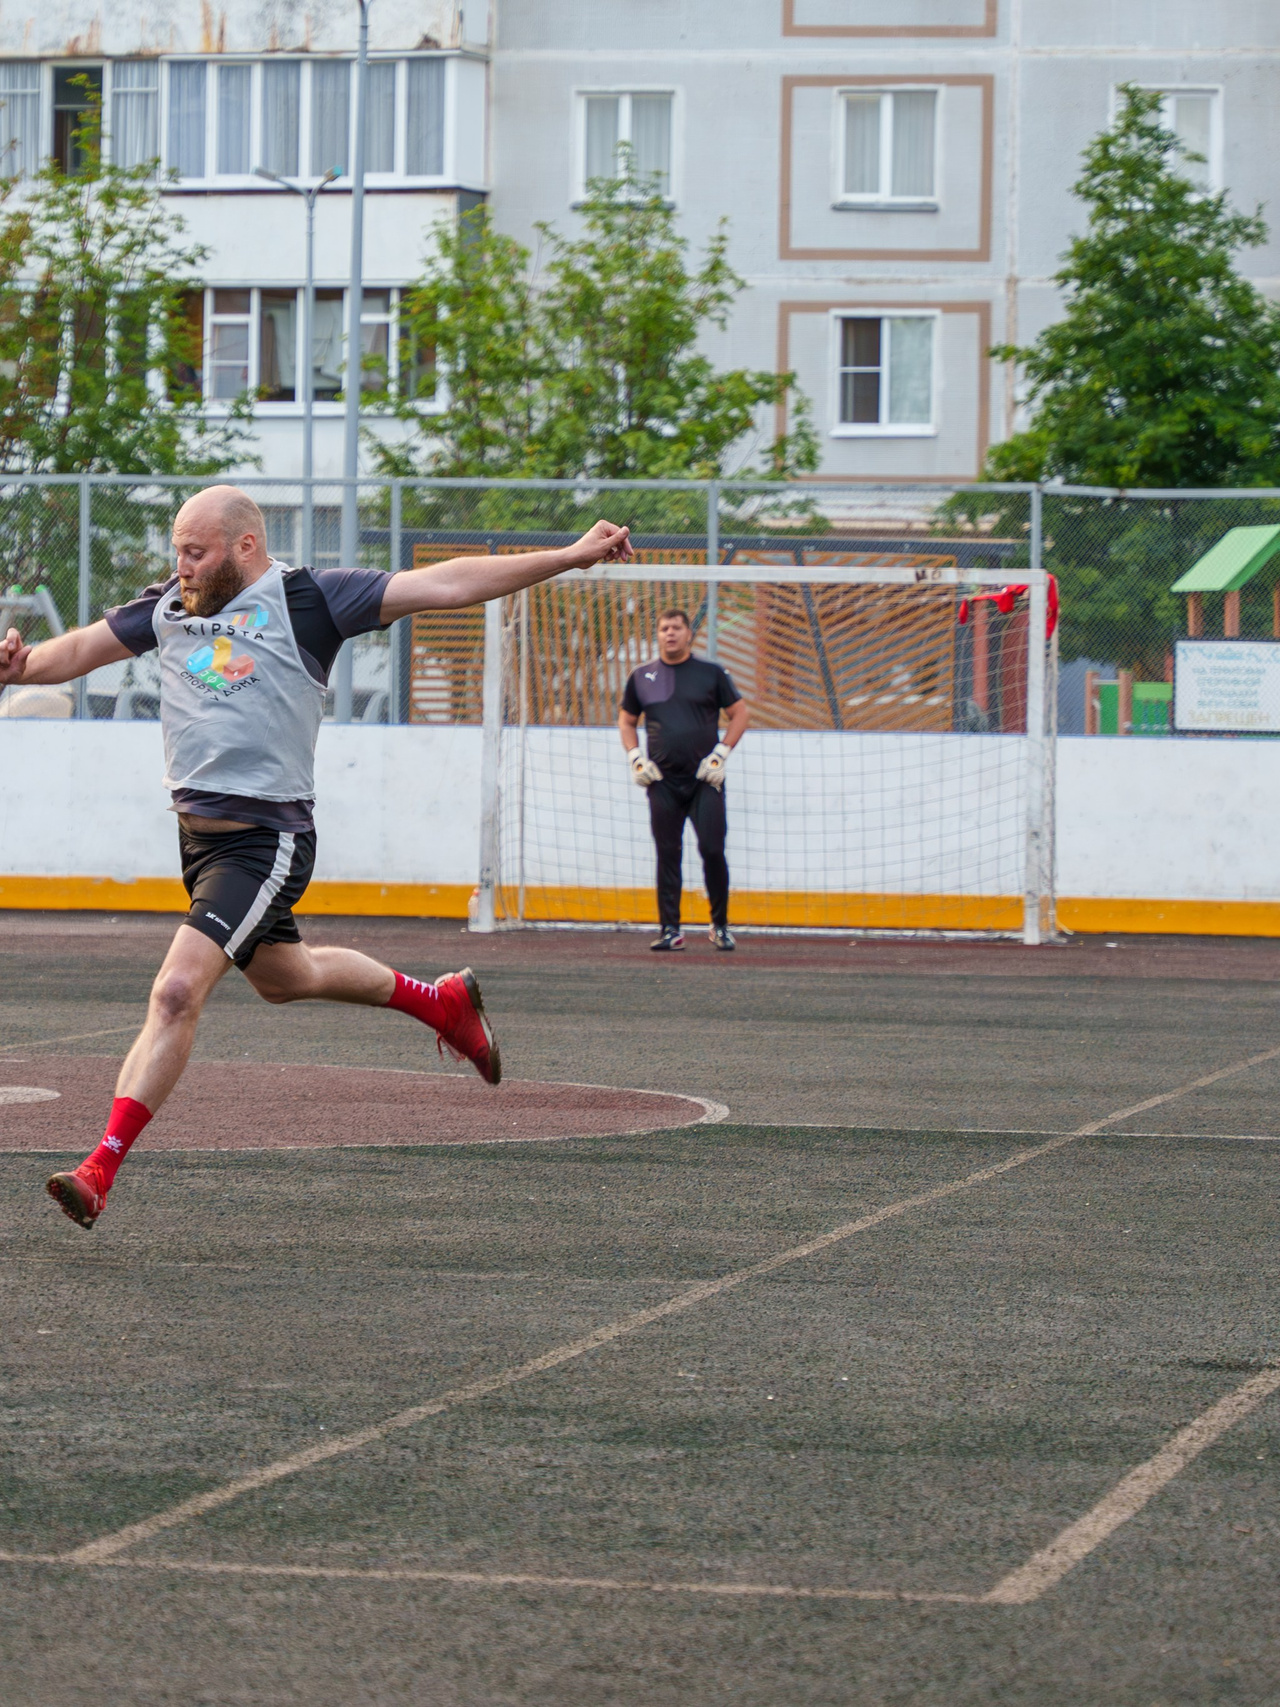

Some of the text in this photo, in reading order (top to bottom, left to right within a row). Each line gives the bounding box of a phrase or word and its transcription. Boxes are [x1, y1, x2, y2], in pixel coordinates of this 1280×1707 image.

[183, 623, 264, 640] KIPSTA
[180, 671, 261, 702] СПОРТ У ДОМА
